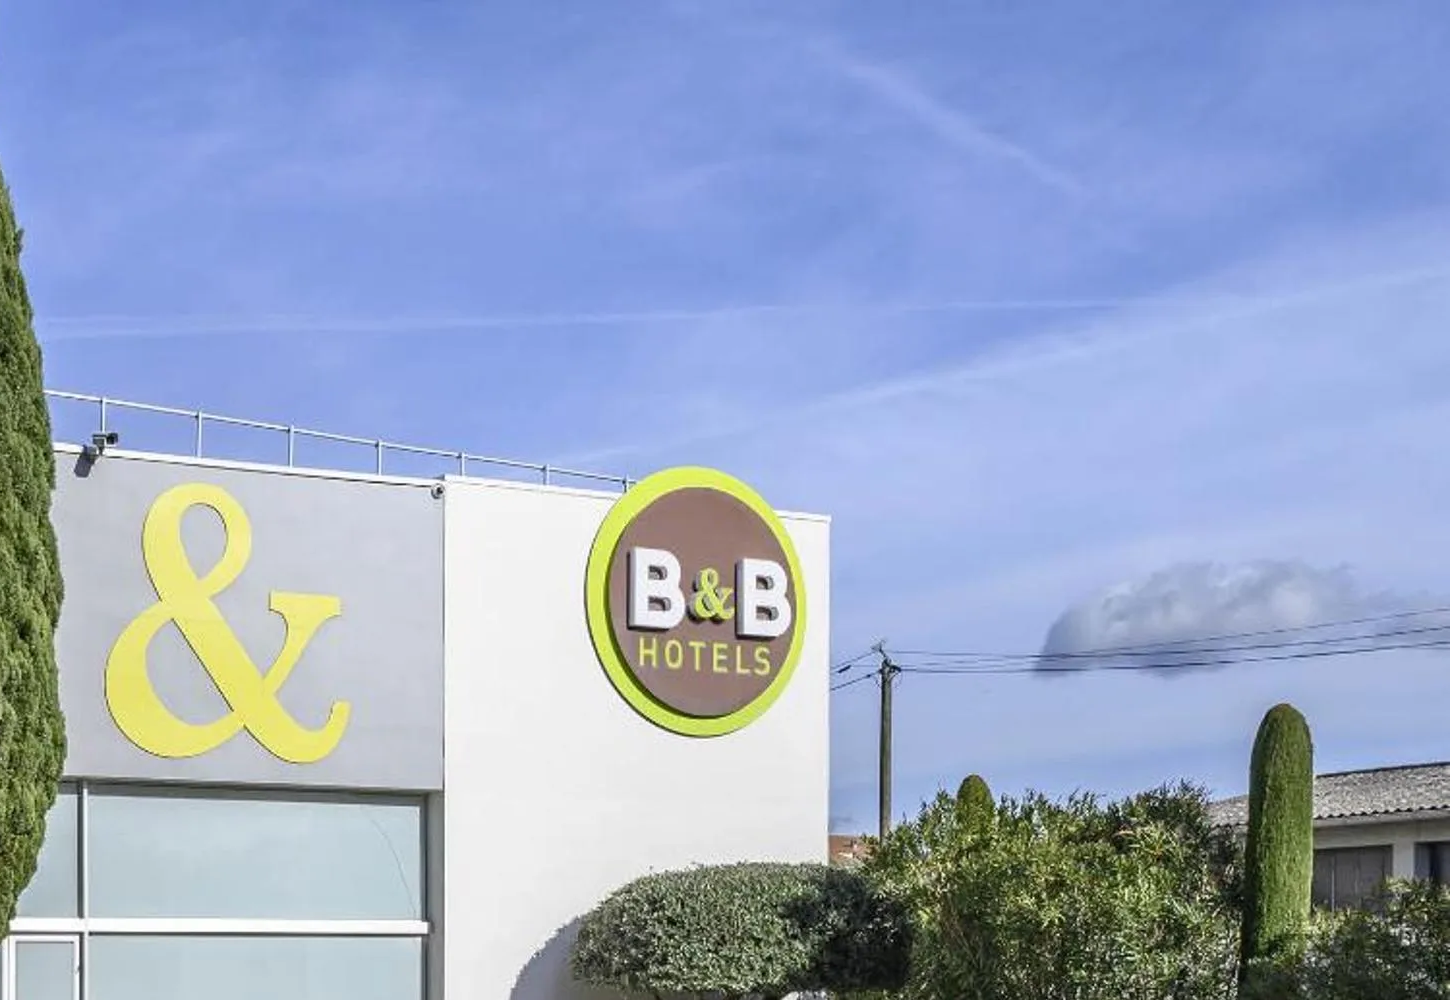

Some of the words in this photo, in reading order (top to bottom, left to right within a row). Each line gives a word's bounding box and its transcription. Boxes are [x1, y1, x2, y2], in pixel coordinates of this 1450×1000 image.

[105, 482, 350, 763] &
[628, 546, 792, 639] B&B
[638, 636, 772, 677] HOTELS
